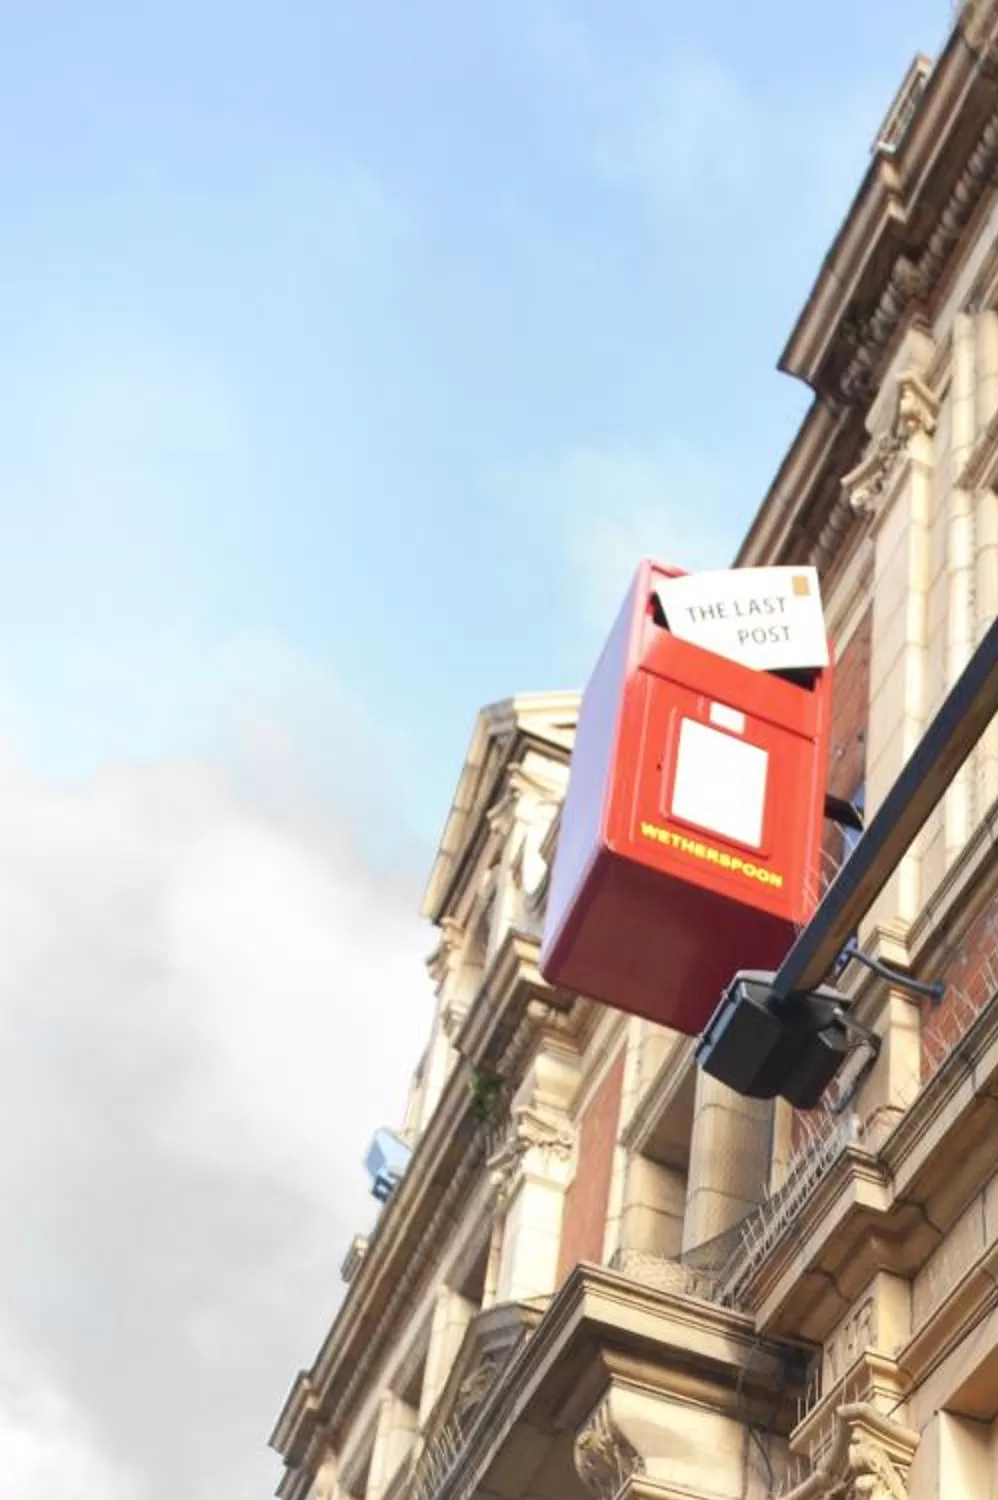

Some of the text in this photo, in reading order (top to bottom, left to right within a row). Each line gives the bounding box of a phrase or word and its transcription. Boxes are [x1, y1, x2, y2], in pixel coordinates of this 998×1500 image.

[685, 596, 786, 623] THE LAST
[736, 625, 790, 646] POST
[640, 821, 783, 888] WETHERSPOON
